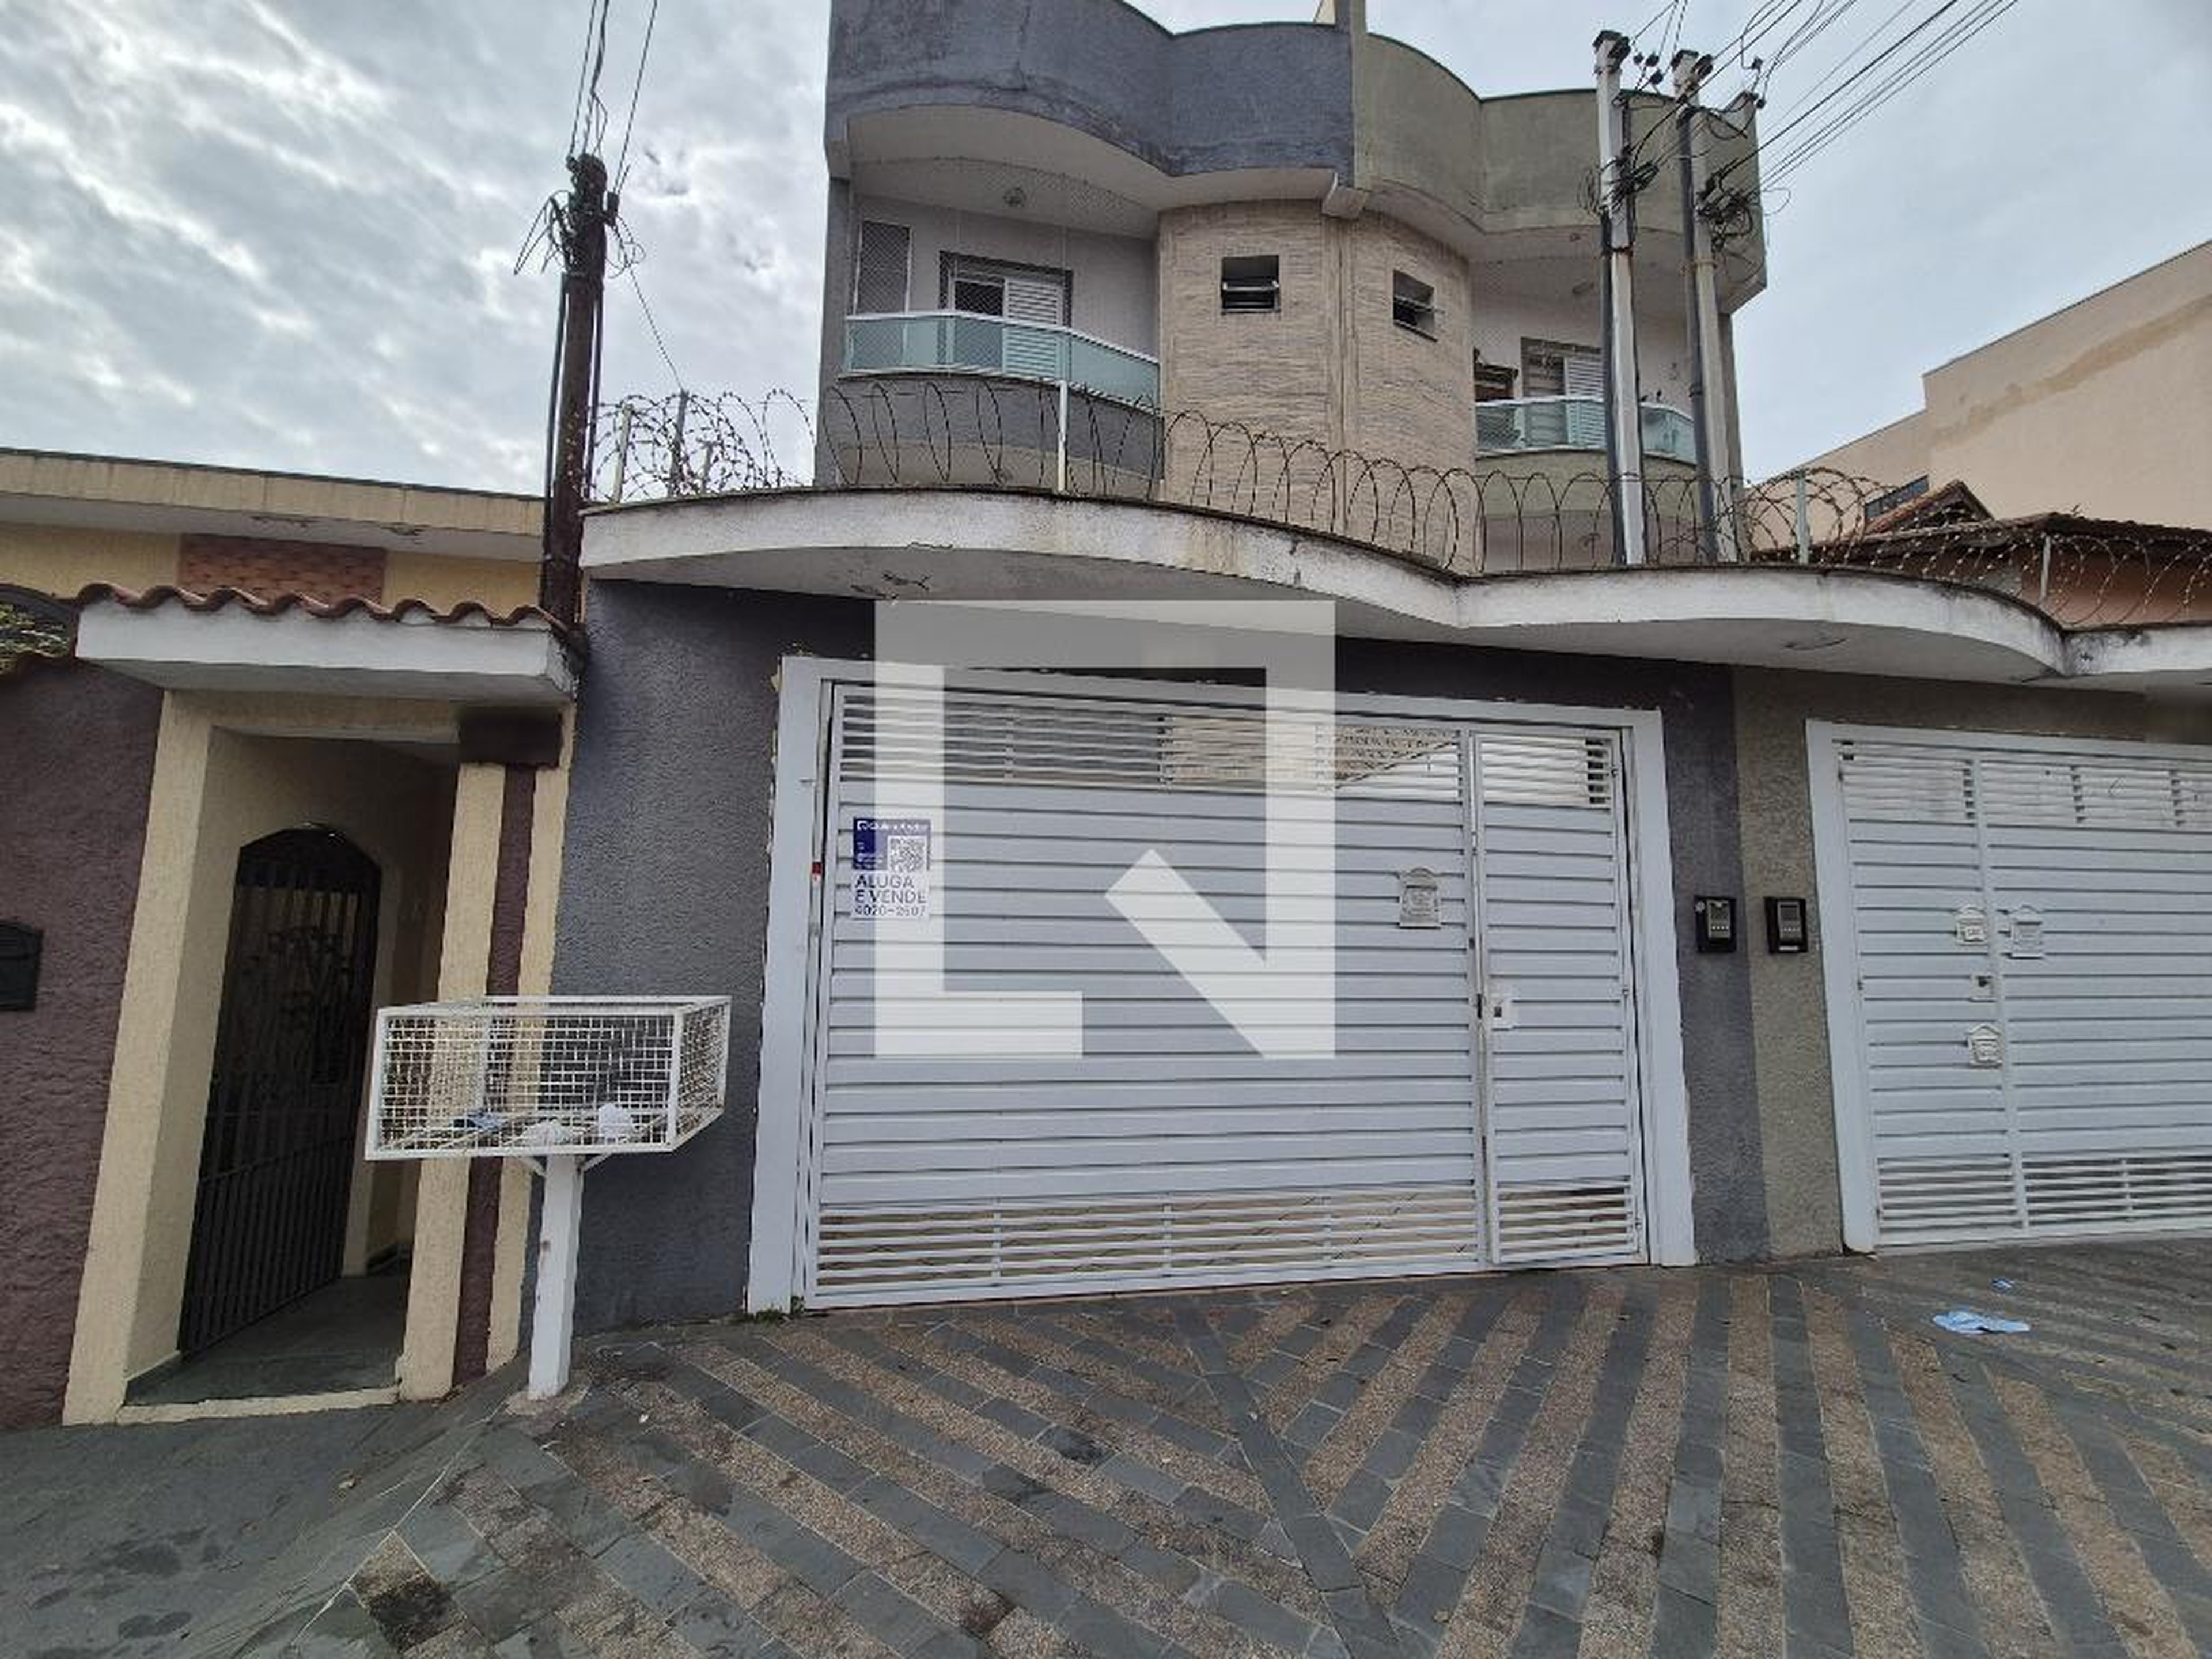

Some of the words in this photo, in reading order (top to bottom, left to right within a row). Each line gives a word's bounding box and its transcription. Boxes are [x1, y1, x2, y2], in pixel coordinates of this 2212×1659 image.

[855, 875, 914, 888] ALUGA
[855, 889, 865, 903] E
[869, 890, 927, 904] VENDE
